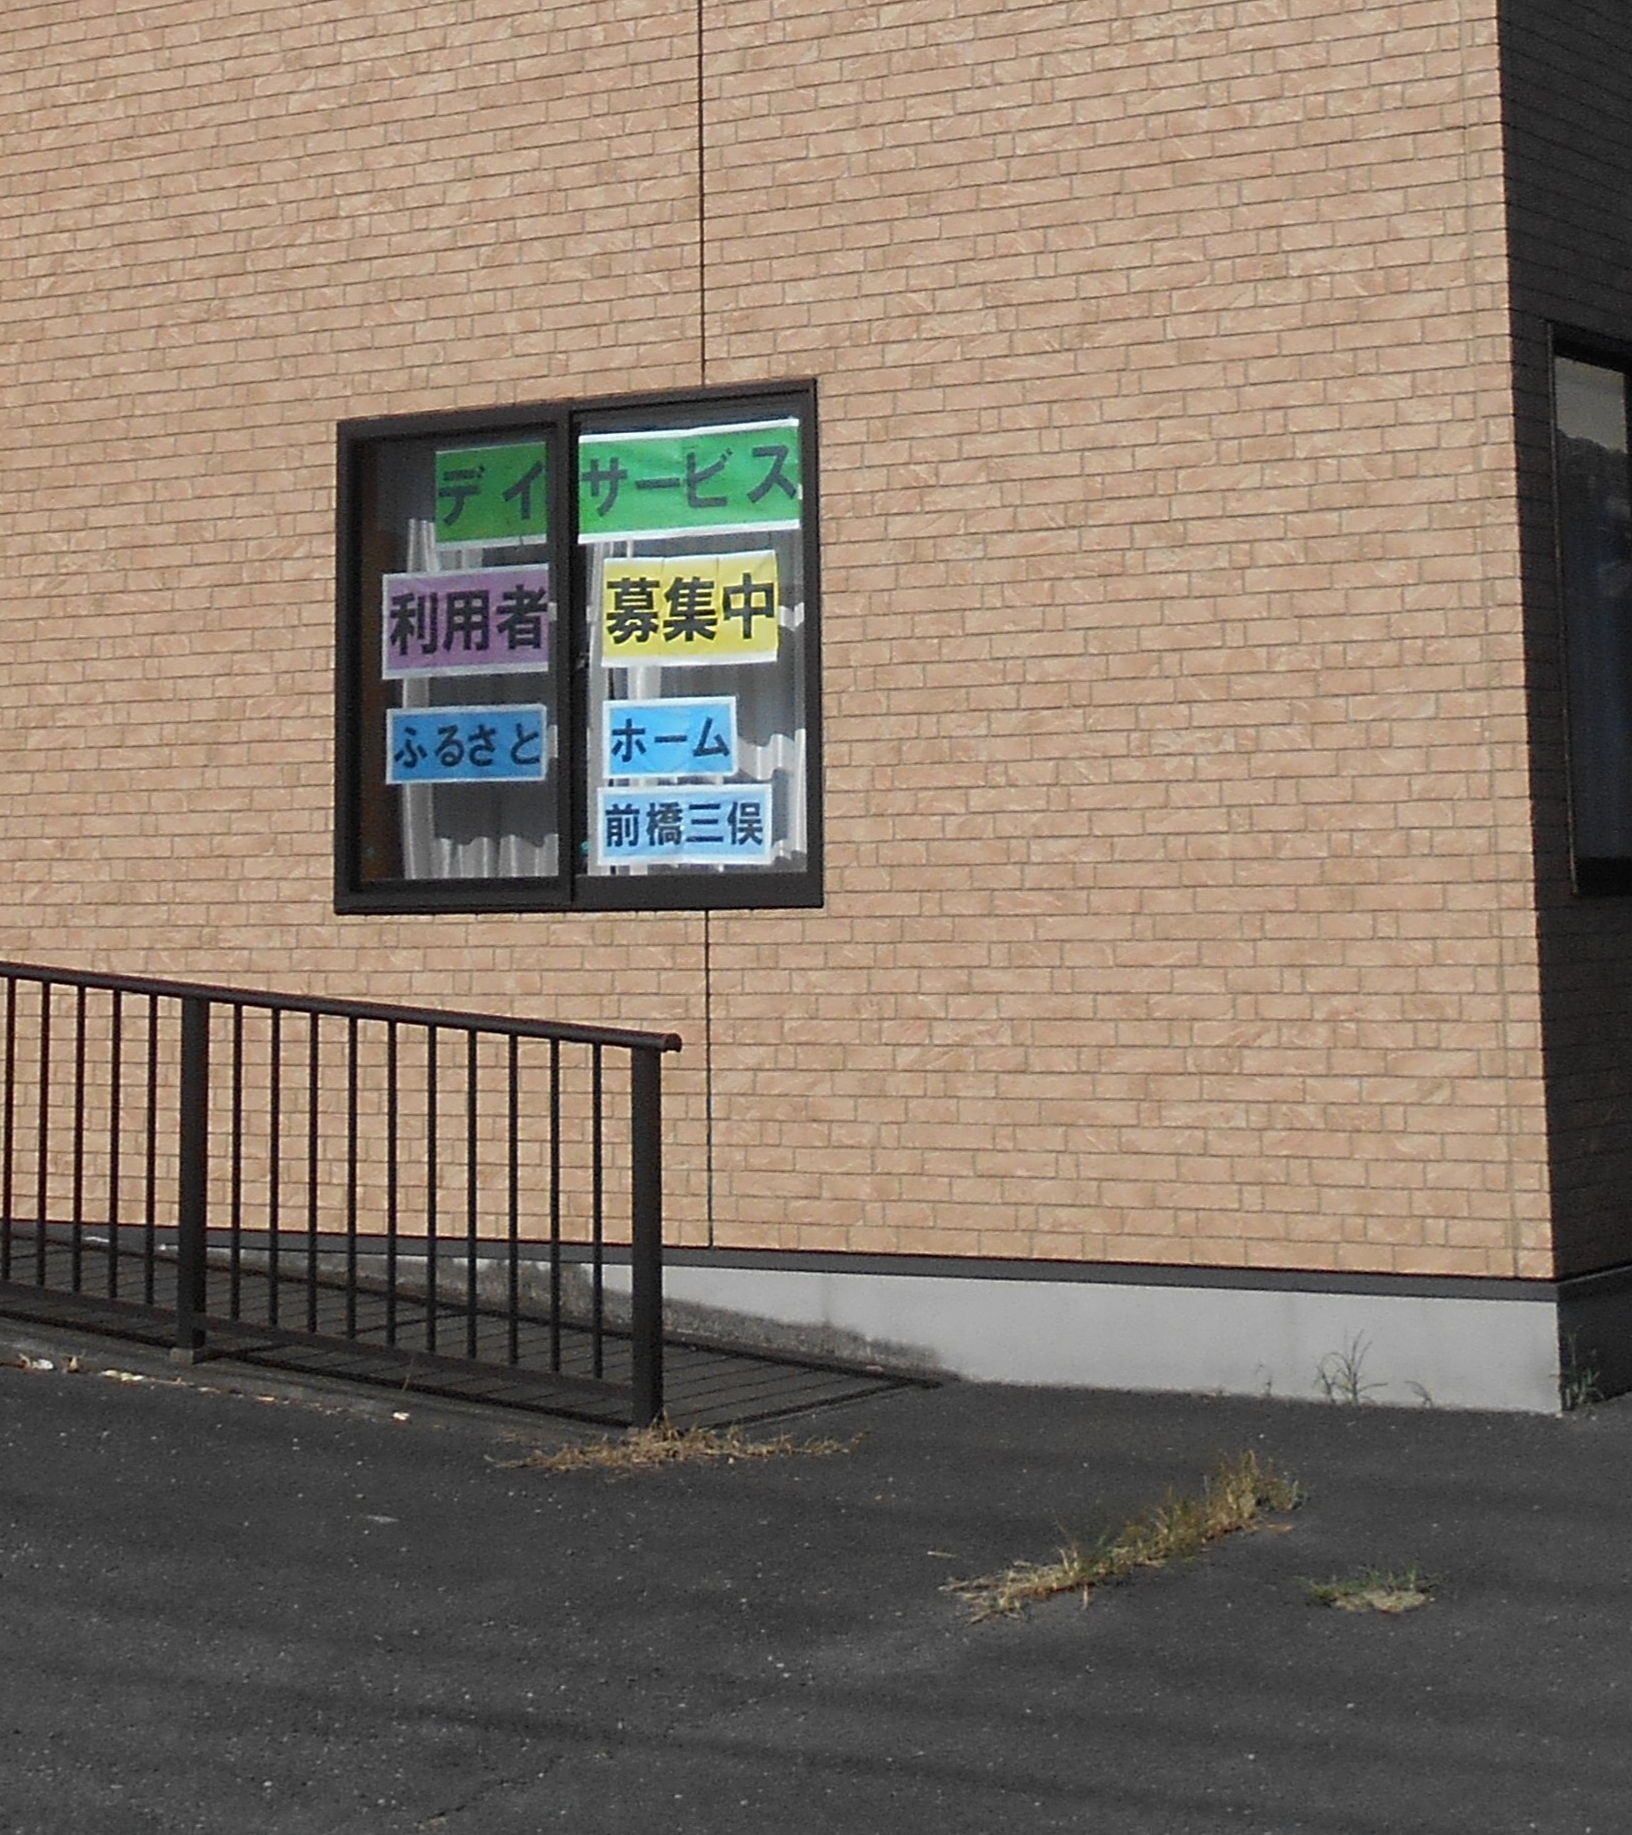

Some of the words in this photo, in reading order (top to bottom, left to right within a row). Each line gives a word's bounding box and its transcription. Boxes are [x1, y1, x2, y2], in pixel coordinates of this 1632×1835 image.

[438, 459, 546, 526] デイ
[581, 443, 798, 518] サービス
[389, 584, 548, 656] 利用者
[605, 572, 776, 643] 募集中
[393, 722, 541, 768] ふるさと
[610, 716, 730, 762] ホーム
[605, 801, 764, 847] 前橋三俣
